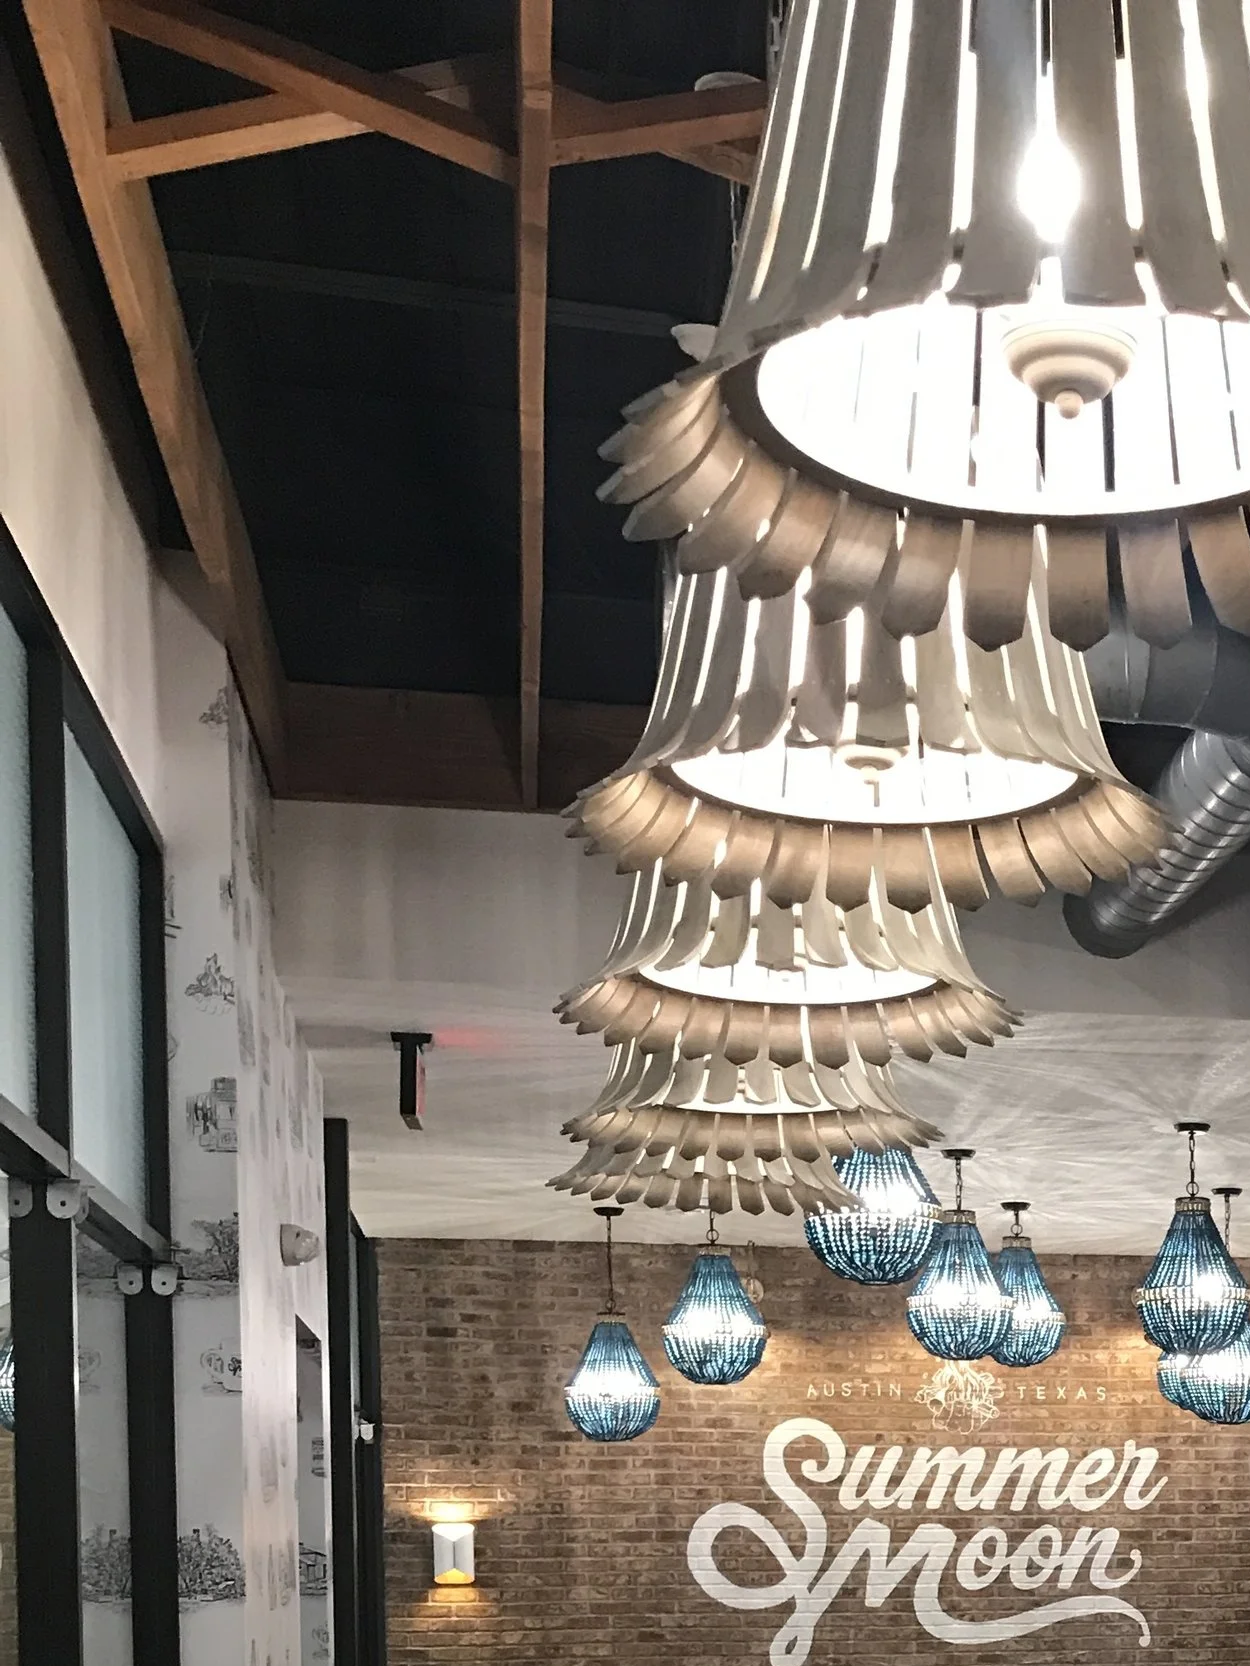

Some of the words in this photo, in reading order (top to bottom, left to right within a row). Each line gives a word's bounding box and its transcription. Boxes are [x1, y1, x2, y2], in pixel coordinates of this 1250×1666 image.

[806, 1383, 901, 1398] AUSTIN
[1016, 1386, 1107, 1400] TEXAS
[687, 1417, 1168, 1608] Summer
